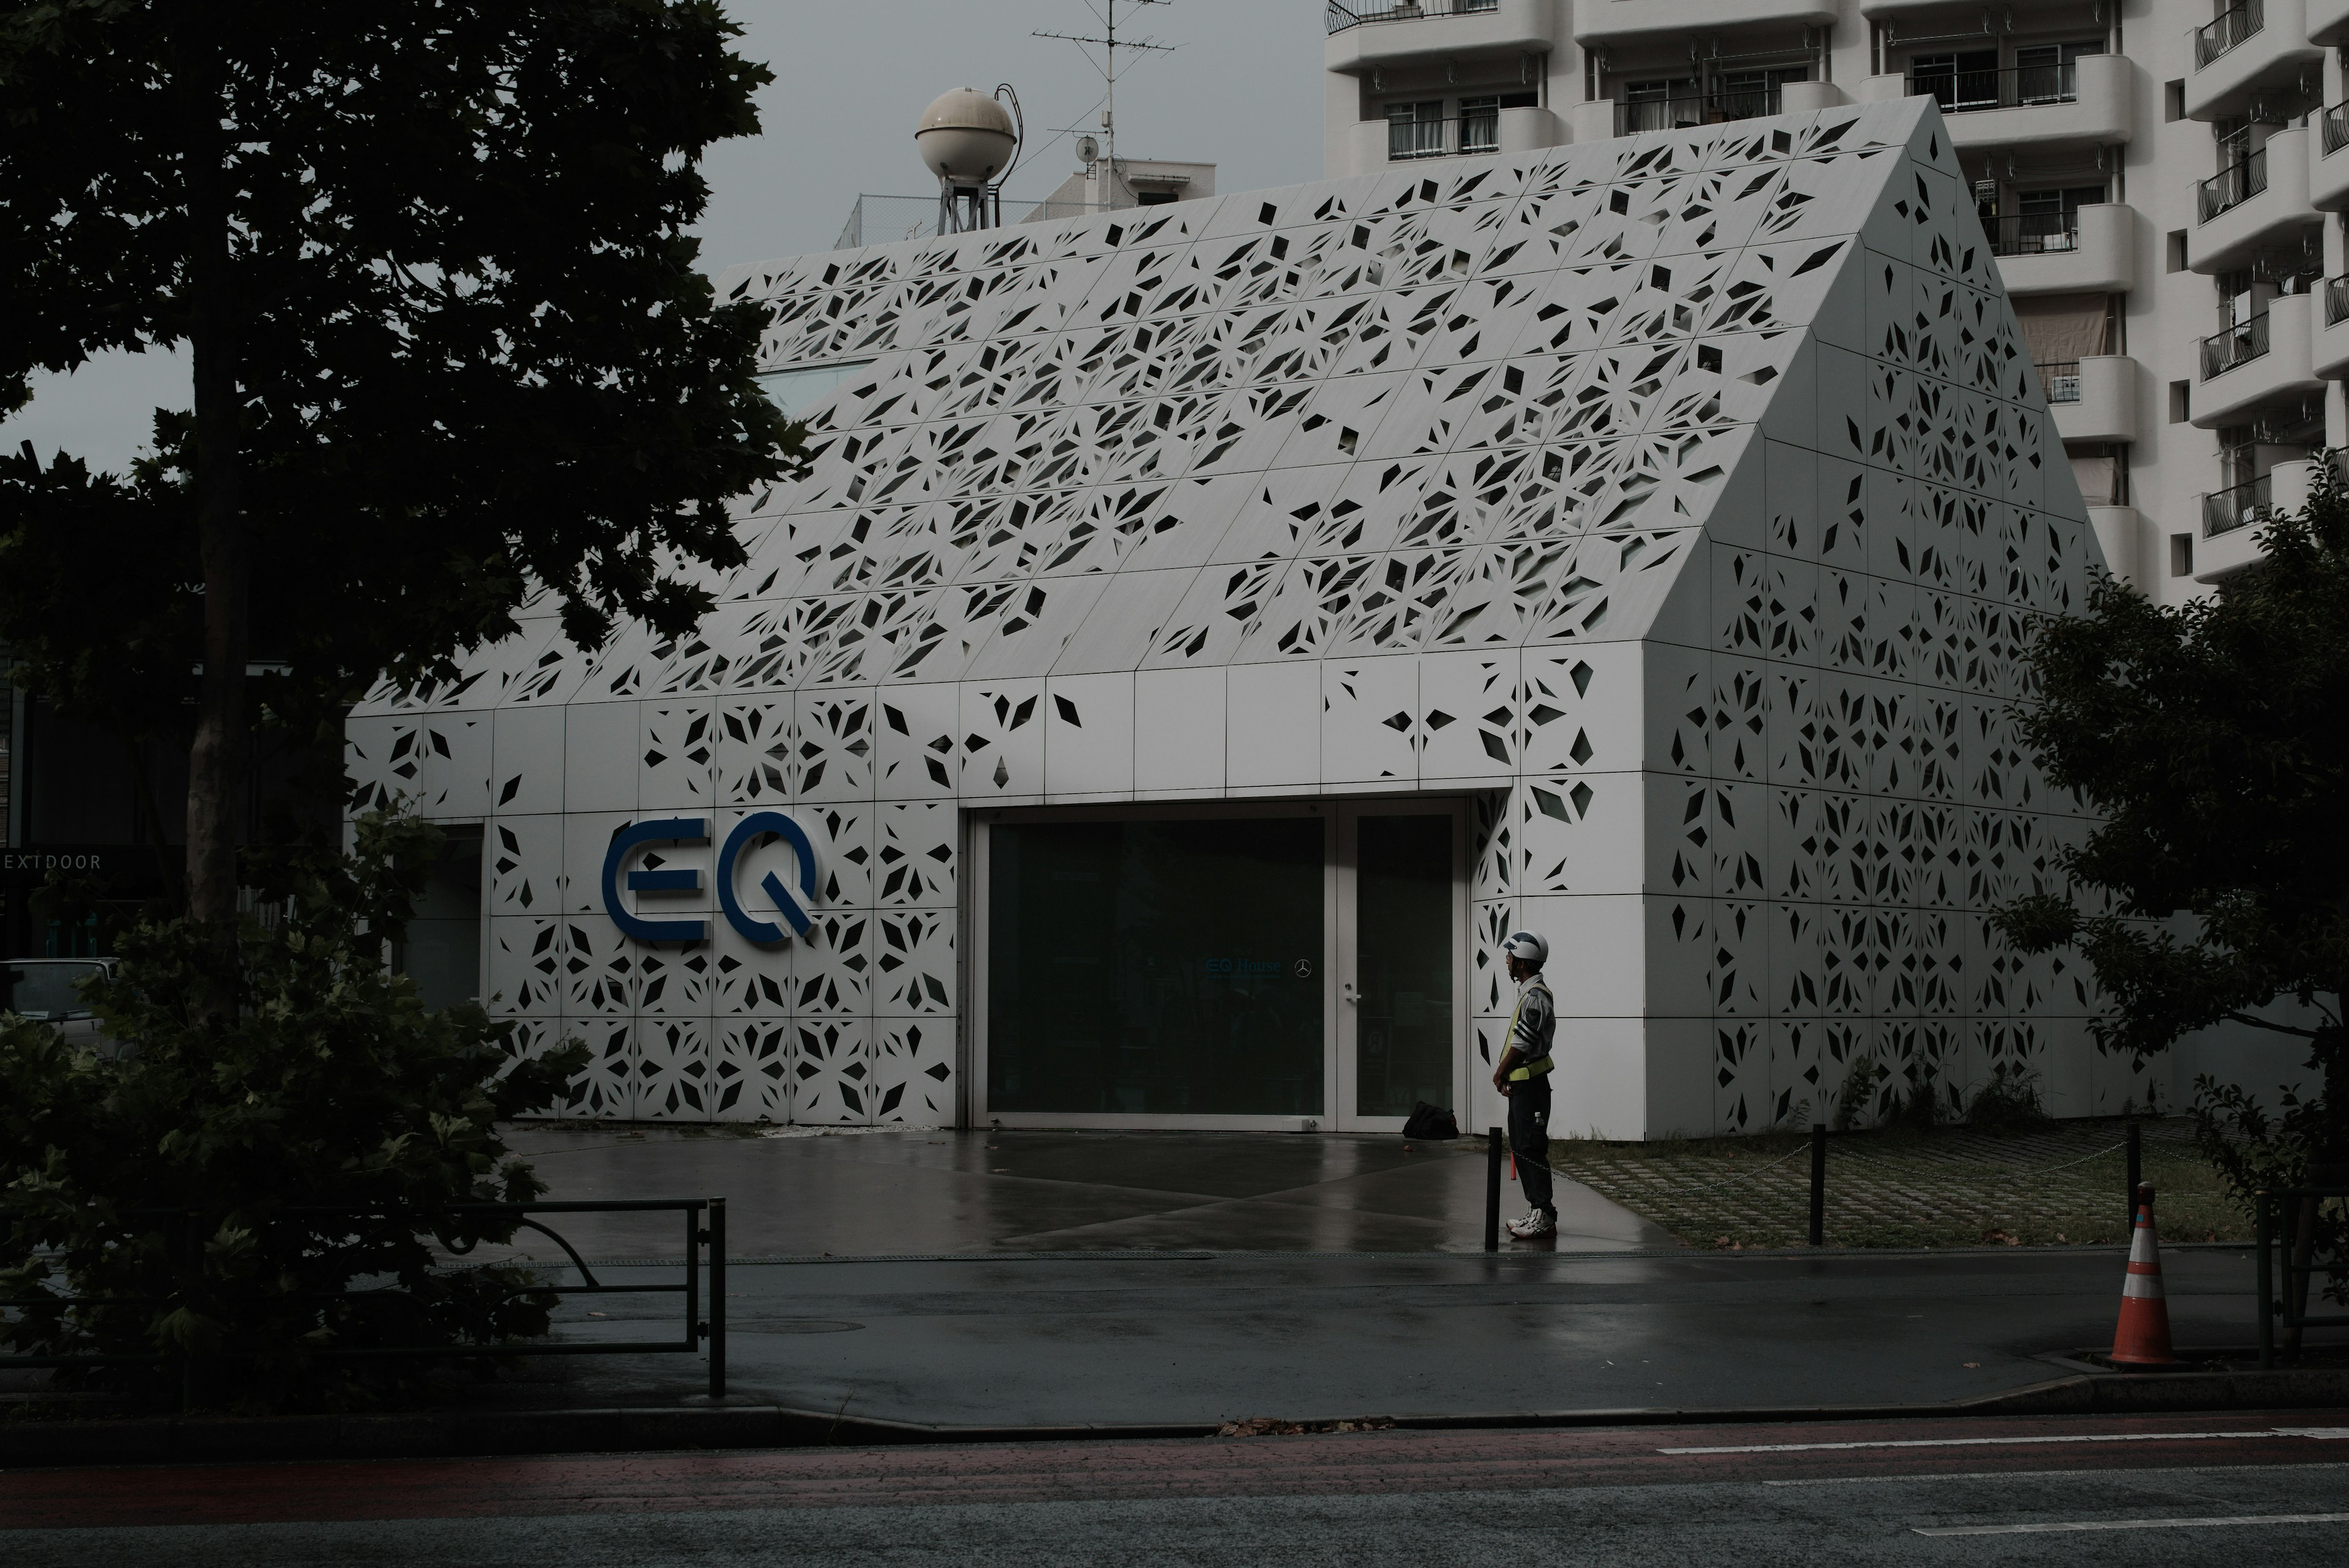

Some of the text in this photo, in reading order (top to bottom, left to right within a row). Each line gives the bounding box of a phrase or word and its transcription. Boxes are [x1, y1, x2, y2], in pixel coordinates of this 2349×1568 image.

[603, 812, 822, 943] EQ
[1205, 958, 1282, 972] EQ House
